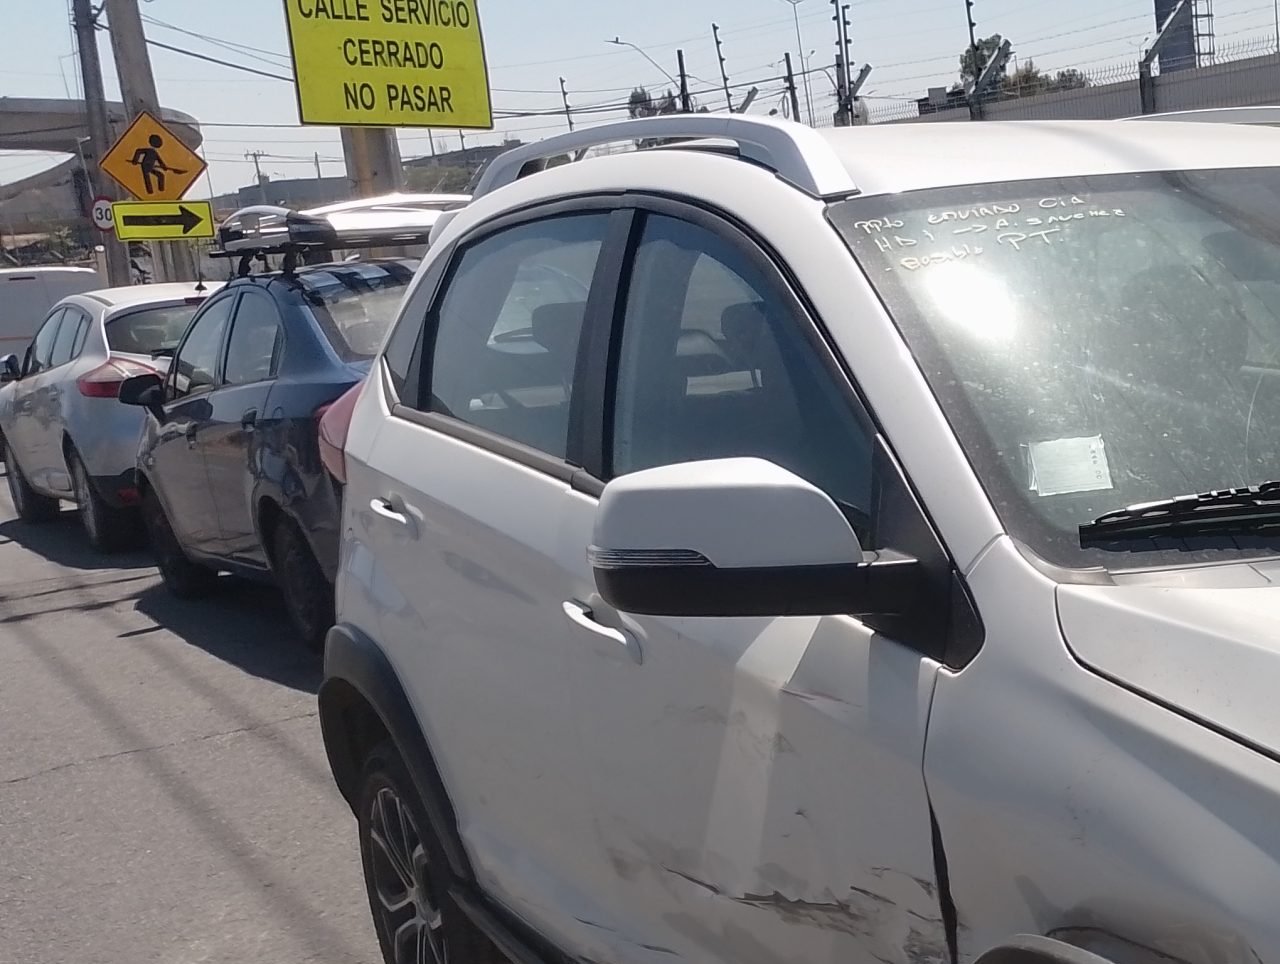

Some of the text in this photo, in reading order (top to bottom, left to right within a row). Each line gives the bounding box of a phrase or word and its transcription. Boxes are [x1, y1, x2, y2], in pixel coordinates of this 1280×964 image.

[298, 0, 470, 28] CALLE SERVICIO
[343, 37, 444, 70] CERRADO
[343, 82, 454, 113] NO PASAR
[95, 207, 113, 222] 30
